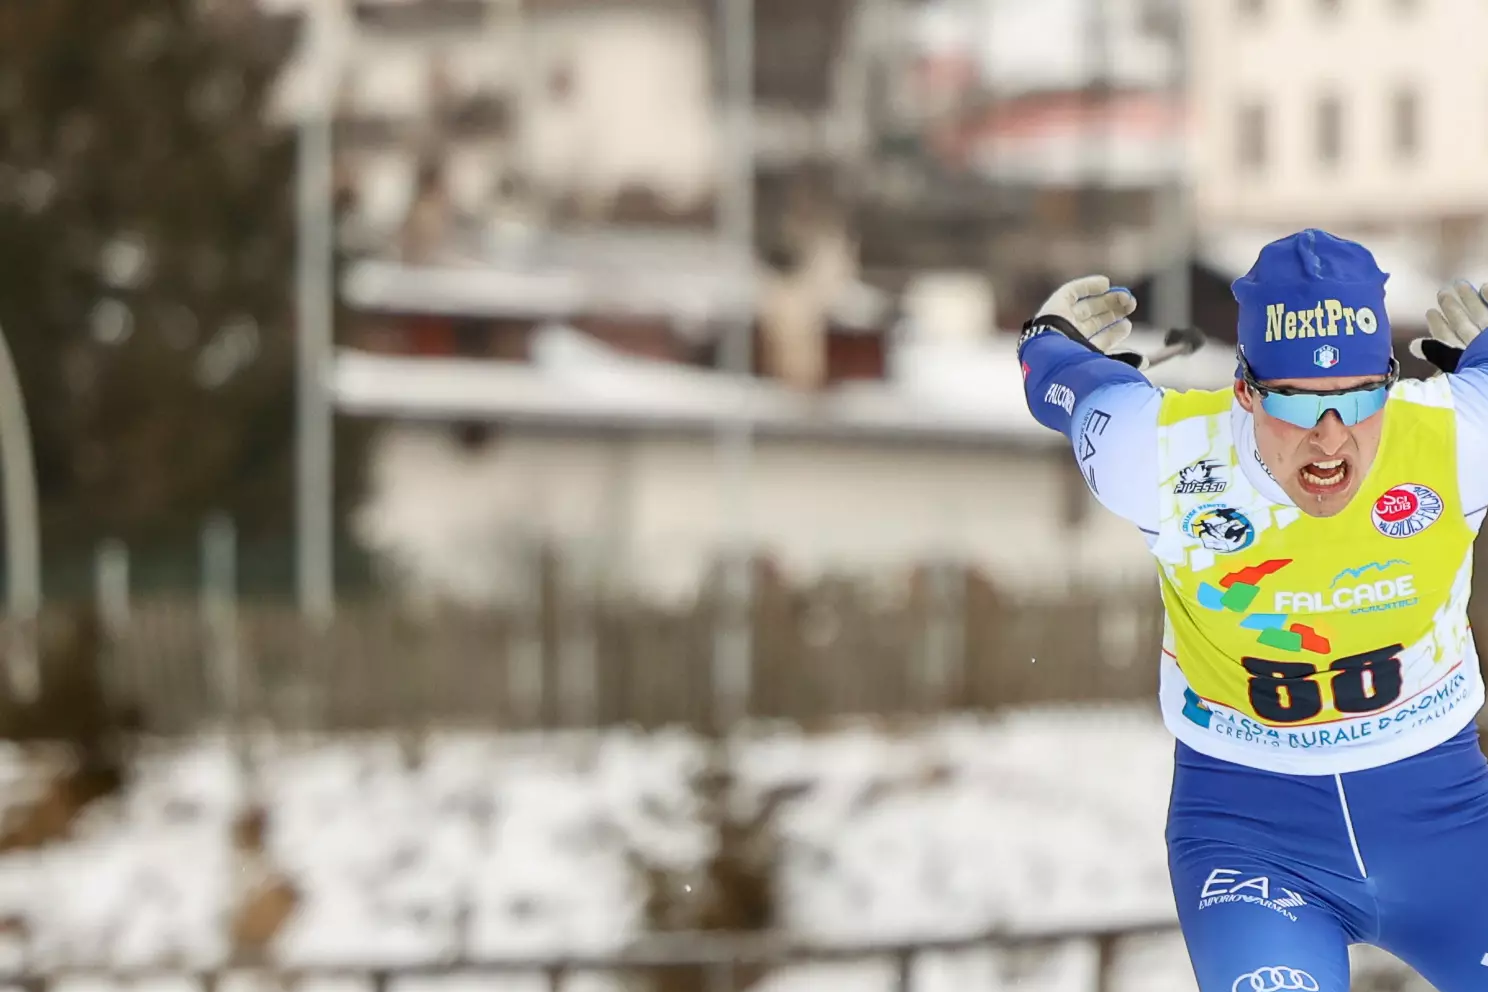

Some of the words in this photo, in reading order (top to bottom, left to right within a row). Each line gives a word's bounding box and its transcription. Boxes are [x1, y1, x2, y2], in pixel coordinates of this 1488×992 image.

[1265, 299, 1378, 343] NextPro
[1375, 501, 1412, 514] CLUB
[1383, 494, 1409, 506] SCI
[1274, 574, 1417, 614] FALCADE
[1240, 643, 1406, 723] 88
[1198, 892, 1247, 911] EMPORIO
[1257, 897, 1298, 923] ARMANI
